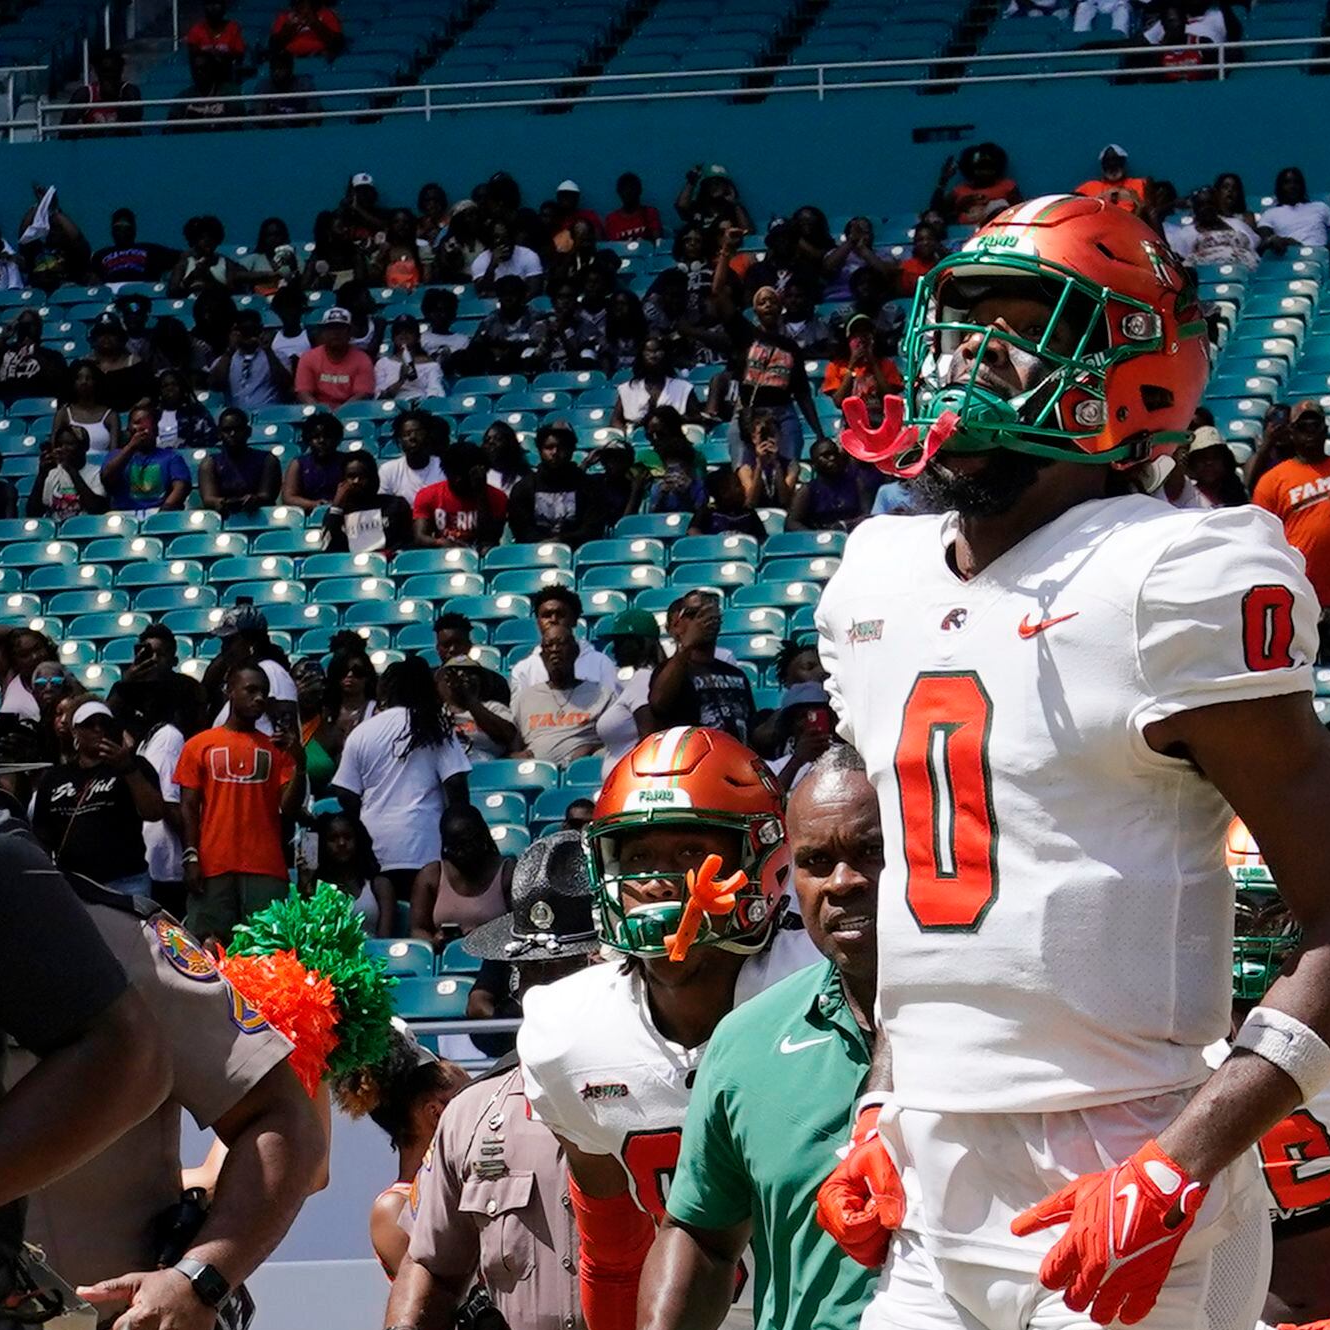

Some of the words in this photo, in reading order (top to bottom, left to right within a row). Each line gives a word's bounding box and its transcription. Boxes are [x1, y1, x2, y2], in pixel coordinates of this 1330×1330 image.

[434, 508, 477, 531] BRN
[1242, 585, 1295, 672] 0
[527, 712, 591, 729] FAMU
[639, 791, 673, 801] FAMU
[894, 670, 999, 933] 0
